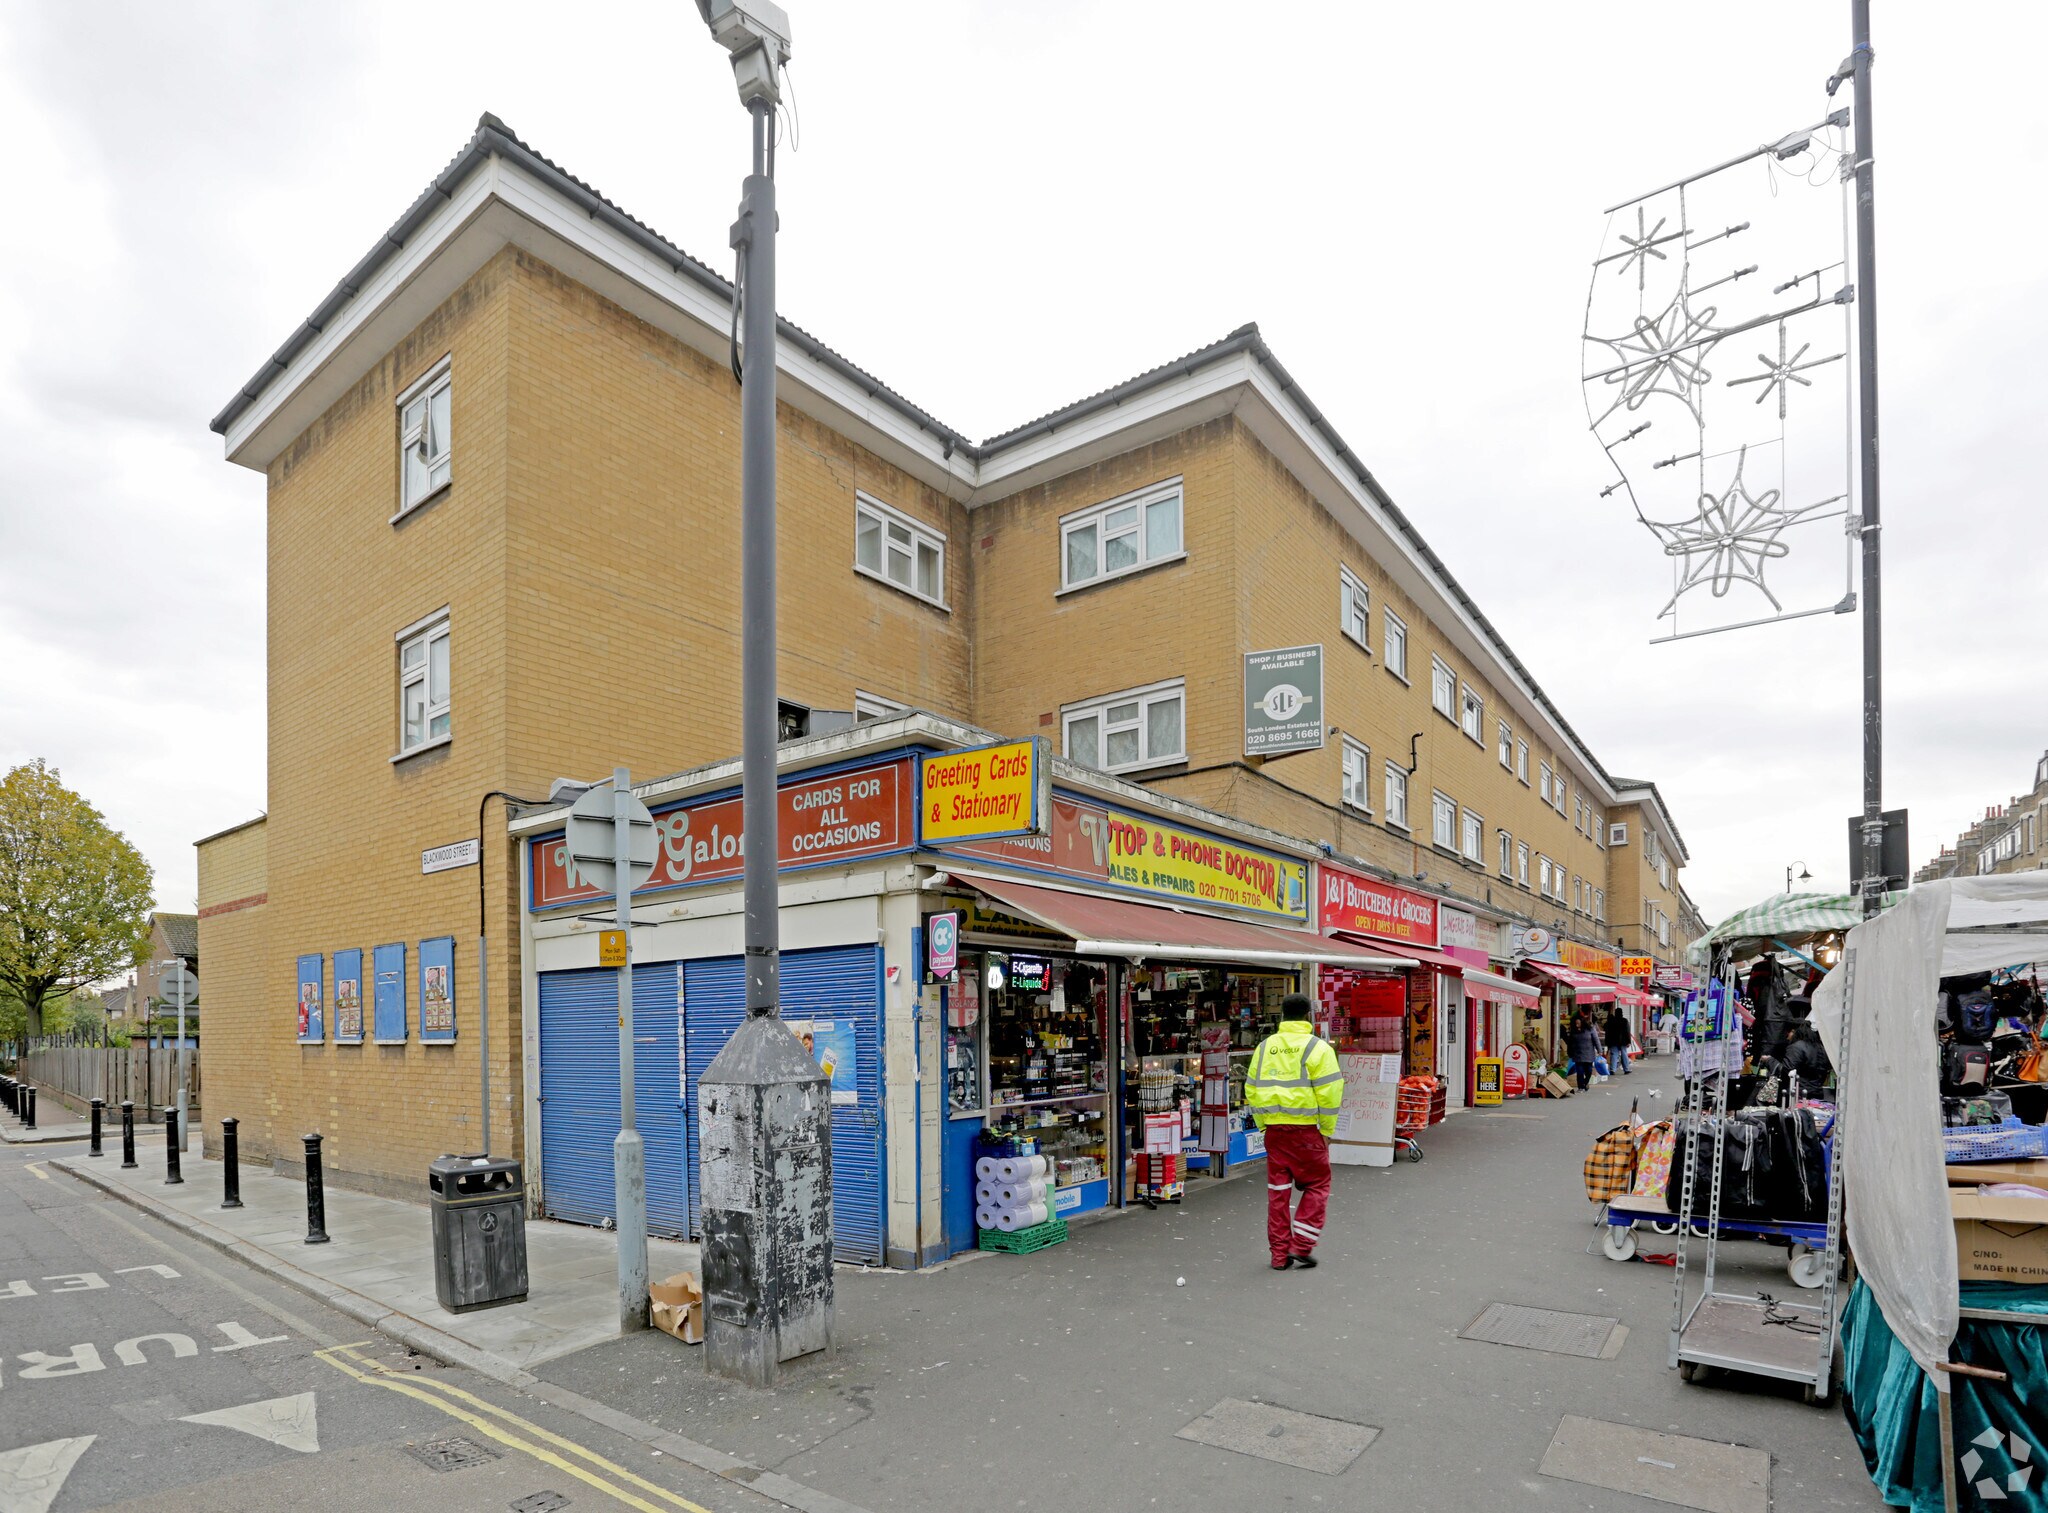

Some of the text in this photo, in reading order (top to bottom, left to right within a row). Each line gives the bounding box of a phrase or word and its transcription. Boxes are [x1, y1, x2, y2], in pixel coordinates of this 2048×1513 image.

[1249, 656, 1271, 665] SHOP
[1276, 650, 1317, 661] BUSINESS
[1261, 660, 1305, 671] AVAILABLE
[1272, 692, 1293, 713] SLE
[1247, 726, 1264, 734] South
[1265, 724, 1286, 732] London
[1287, 722, 1309, 730] Estates
[1247, 729, 1320, 744] 020 8695 1666
[927, 749, 1027, 789] Greeting Cards
[792, 779, 881, 811] CARDS FOR
[931, 791, 1021, 823] & Stationary
[820, 806, 848, 827] ALL
[792, 821, 881, 852] OCCASIONS
[423, 848, 452, 865] BLACKWOOD
[453, 843, 472, 858] STREET
[1153, 831, 1166, 857] &
[1171, 835, 1222, 871] PHONE
[1225, 851, 1276, 904] DOCTOR
[1109, 863, 1195, 894] ALES & REPAIRS
[1199, 882, 1261, 906] 020 7701 5706
[1325, 874, 1431, 925] J&J BUTCHERS & GROCERS
[1355, 915, 1371, 928] OPEN
[1377, 919, 1390, 934] DAYS
[1396, 923, 1411, 937] WEEK
[932, 954, 953, 966] payzone
[1621, 958, 1651, 966] K & K
[1012, 961, 1043, 976] E-Cigarette
[1621, 967, 1651, 975] FOOD
[1012, 976, 1042, 990] E-Liquids
[948, 1000, 978, 1008] NGLAND
[1480, 1082, 1497, 1090] HERE
[1341, 1098, 1390, 1109] CHRISTMAS
[1354, 1109, 1383, 1120] CARDS
[1972, 1250, 2002, 1259] C/NO:
[1973, 1264, 2003, 1272] MADE
[0, 1322, 288, 1387] TUR
